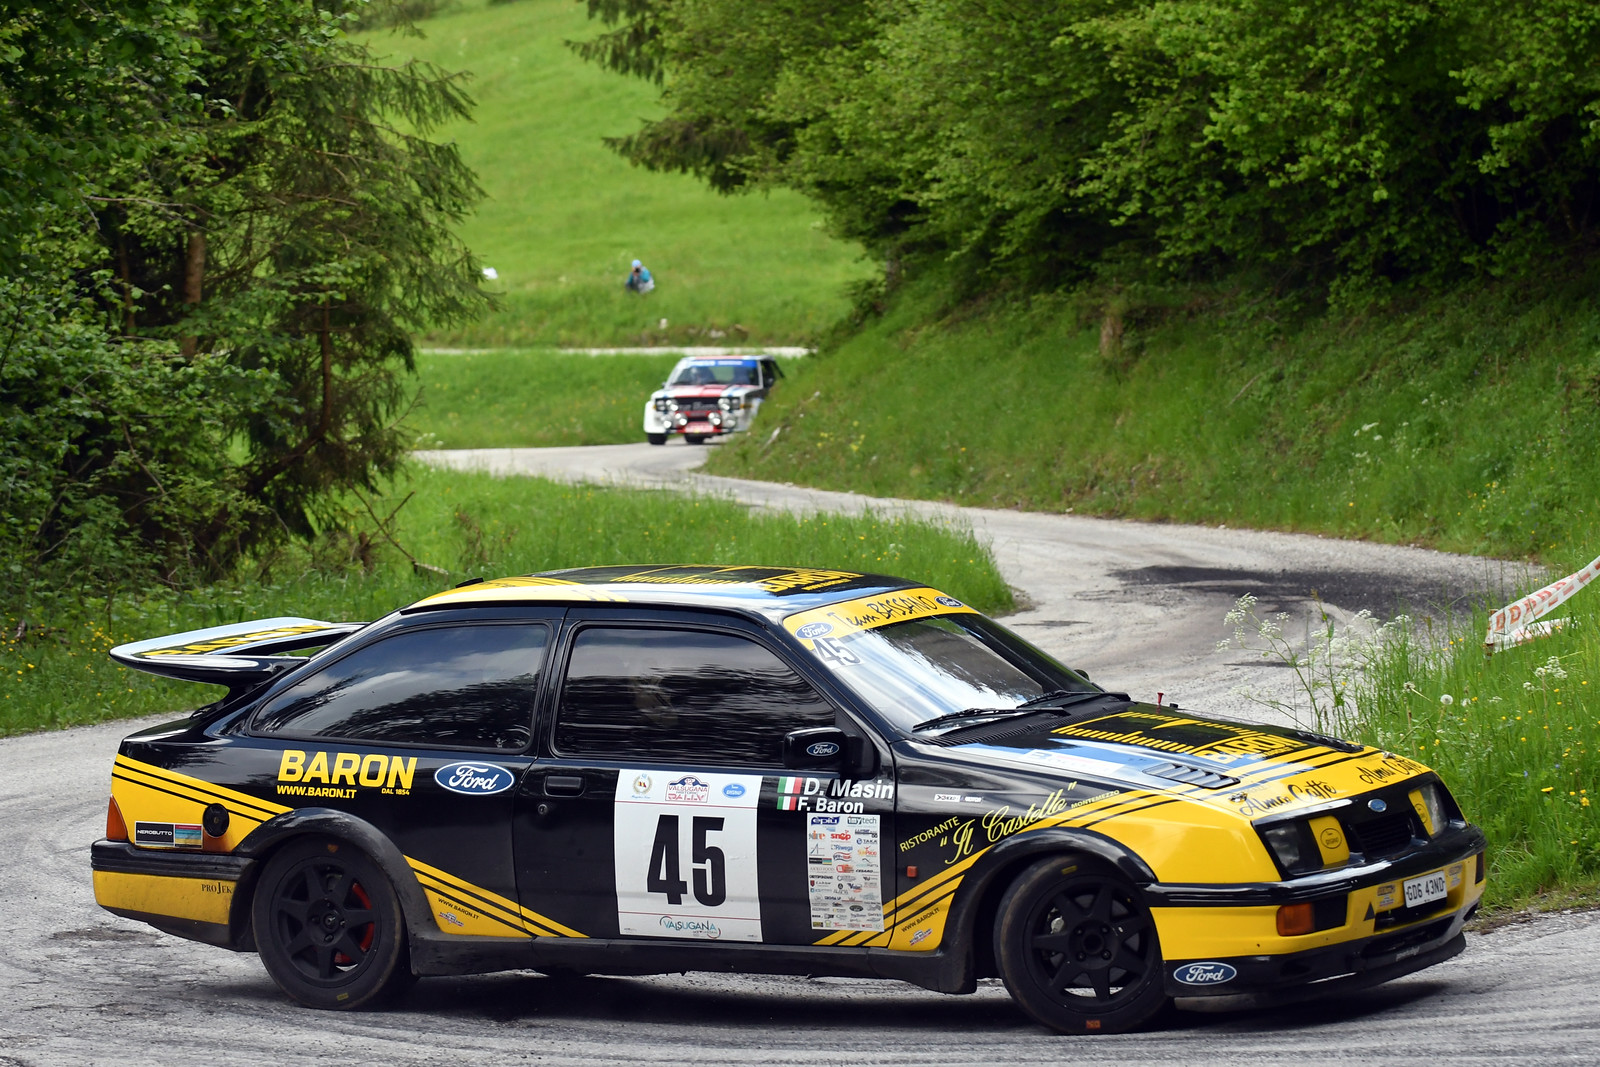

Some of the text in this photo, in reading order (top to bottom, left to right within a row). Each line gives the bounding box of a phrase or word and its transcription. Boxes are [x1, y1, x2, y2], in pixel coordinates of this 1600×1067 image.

[827, 595, 938, 629] Team BASSANO
[812, 637, 862, 666] 45
[1193, 734, 1308, 764] BARON
[277, 749, 418, 789] BARON
[1357, 766, 1396, 784] Alma
[276, 784, 357, 799] WWW.BARON.IT
[381, 787, 410, 796] DAL 1854
[803, 777, 894, 799] D. Masin
[1070, 789, 1120, 809] MONTEMEZZO
[797, 798, 864, 814] F. Baron
[1239, 796, 1292, 817] Alma
[899, 816, 960, 852] RISTORANTE
[647, 814, 727, 907] 45
[1407, 883, 1423, 901] GD6
[1425, 877, 1445, 895] 43ND
[663, 920, 717, 931] VALSUGANA
